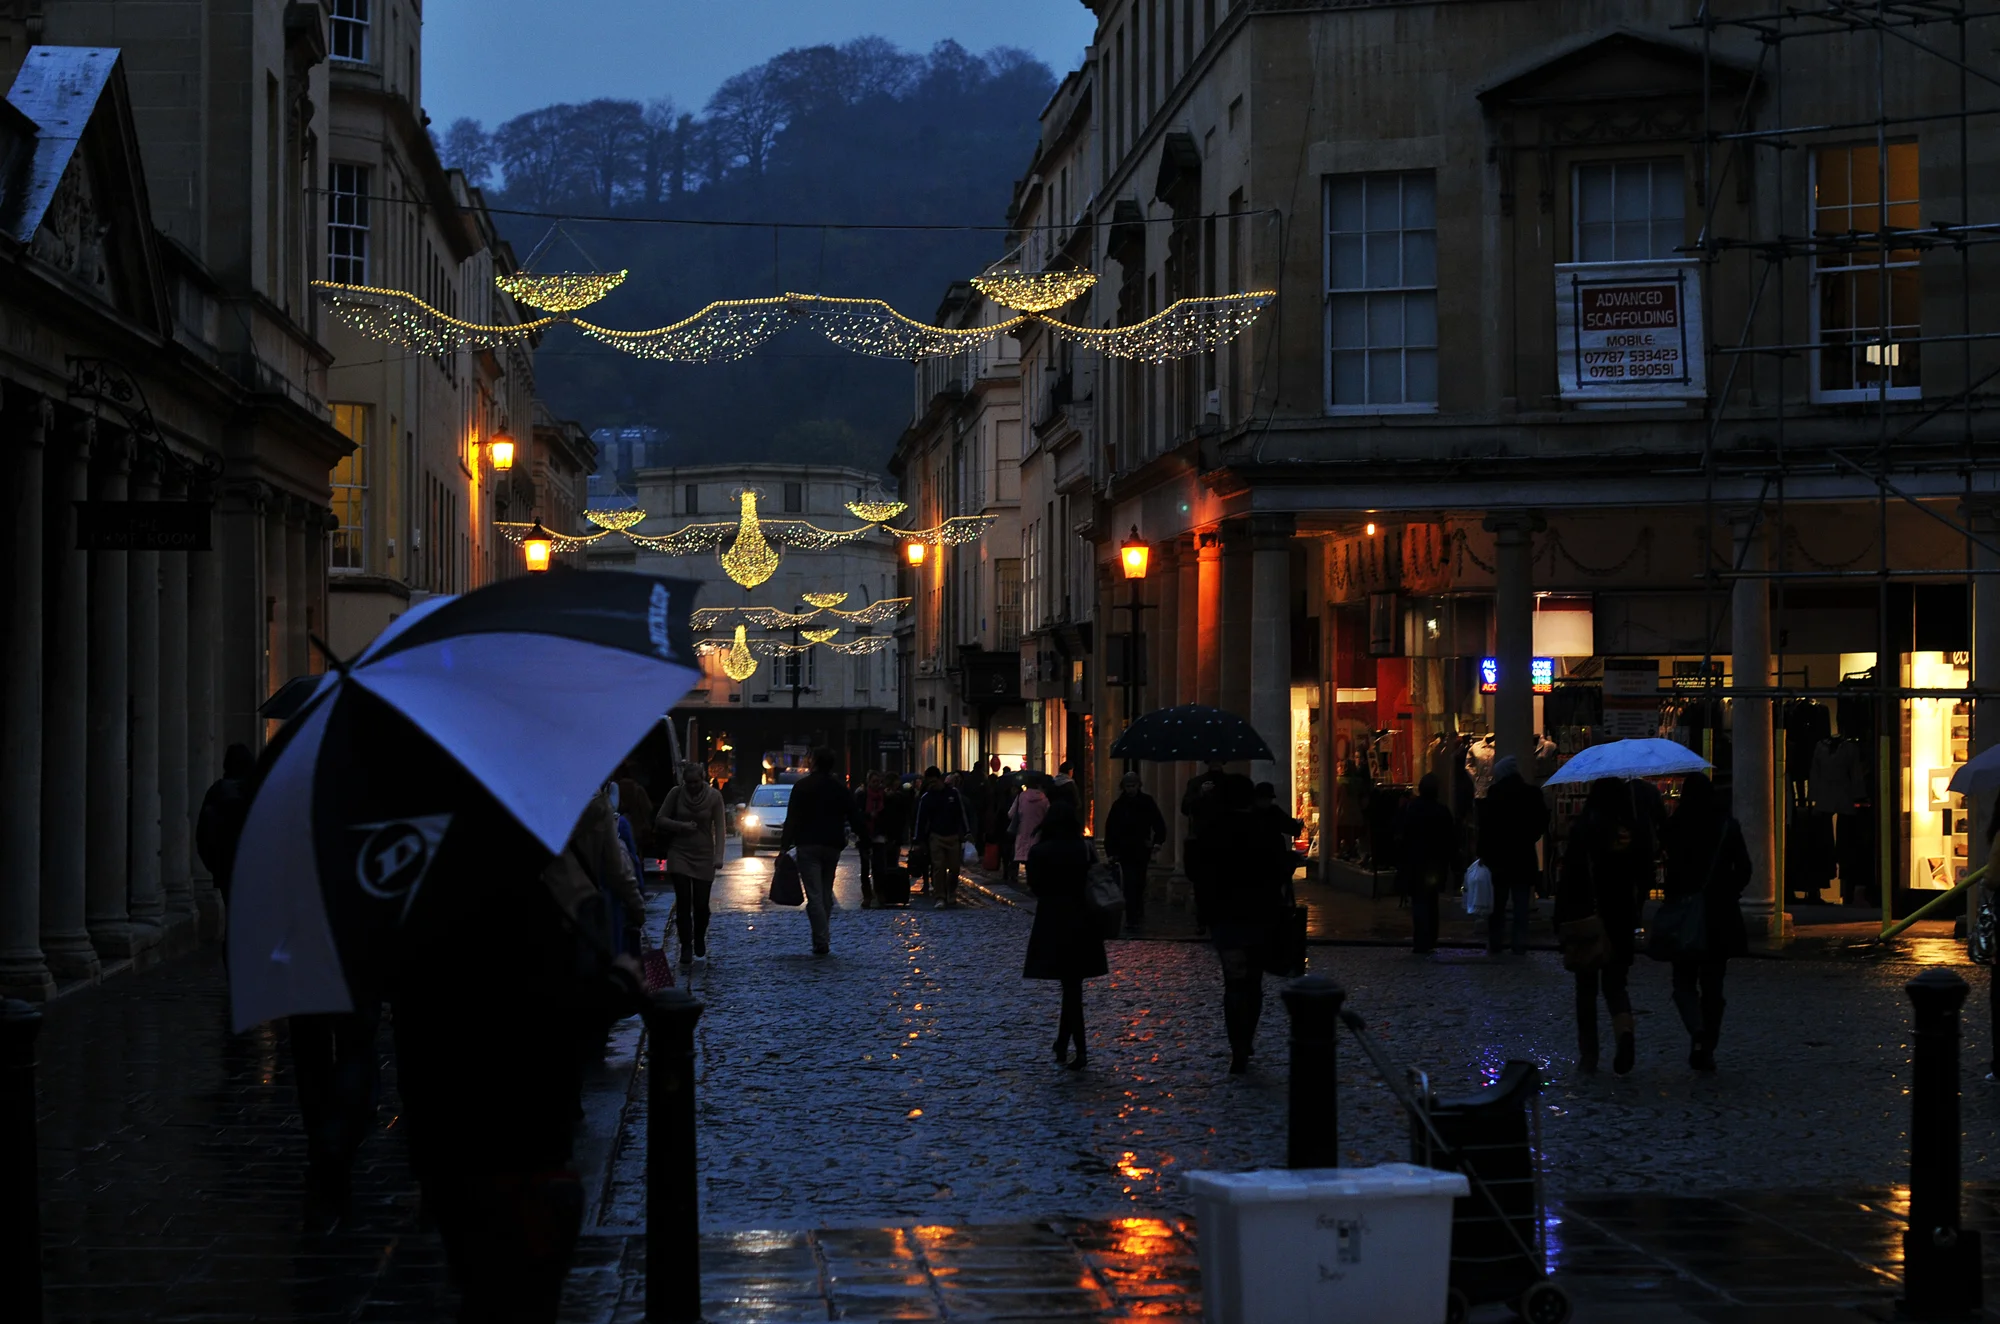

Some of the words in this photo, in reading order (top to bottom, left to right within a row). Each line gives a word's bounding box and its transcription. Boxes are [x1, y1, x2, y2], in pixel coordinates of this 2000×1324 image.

[1596, 290, 1663, 307] ADVANCED
[1586, 310, 1674, 327] SCAFFOLDING
[1606, 334, 1656, 348] MOBILE:
[1584, 350, 1624, 363] 07787
[1629, 349, 1678, 363] 533423
[1590, 364, 1625, 378] 07813
[1629, 363, 1674, 377] 890591
